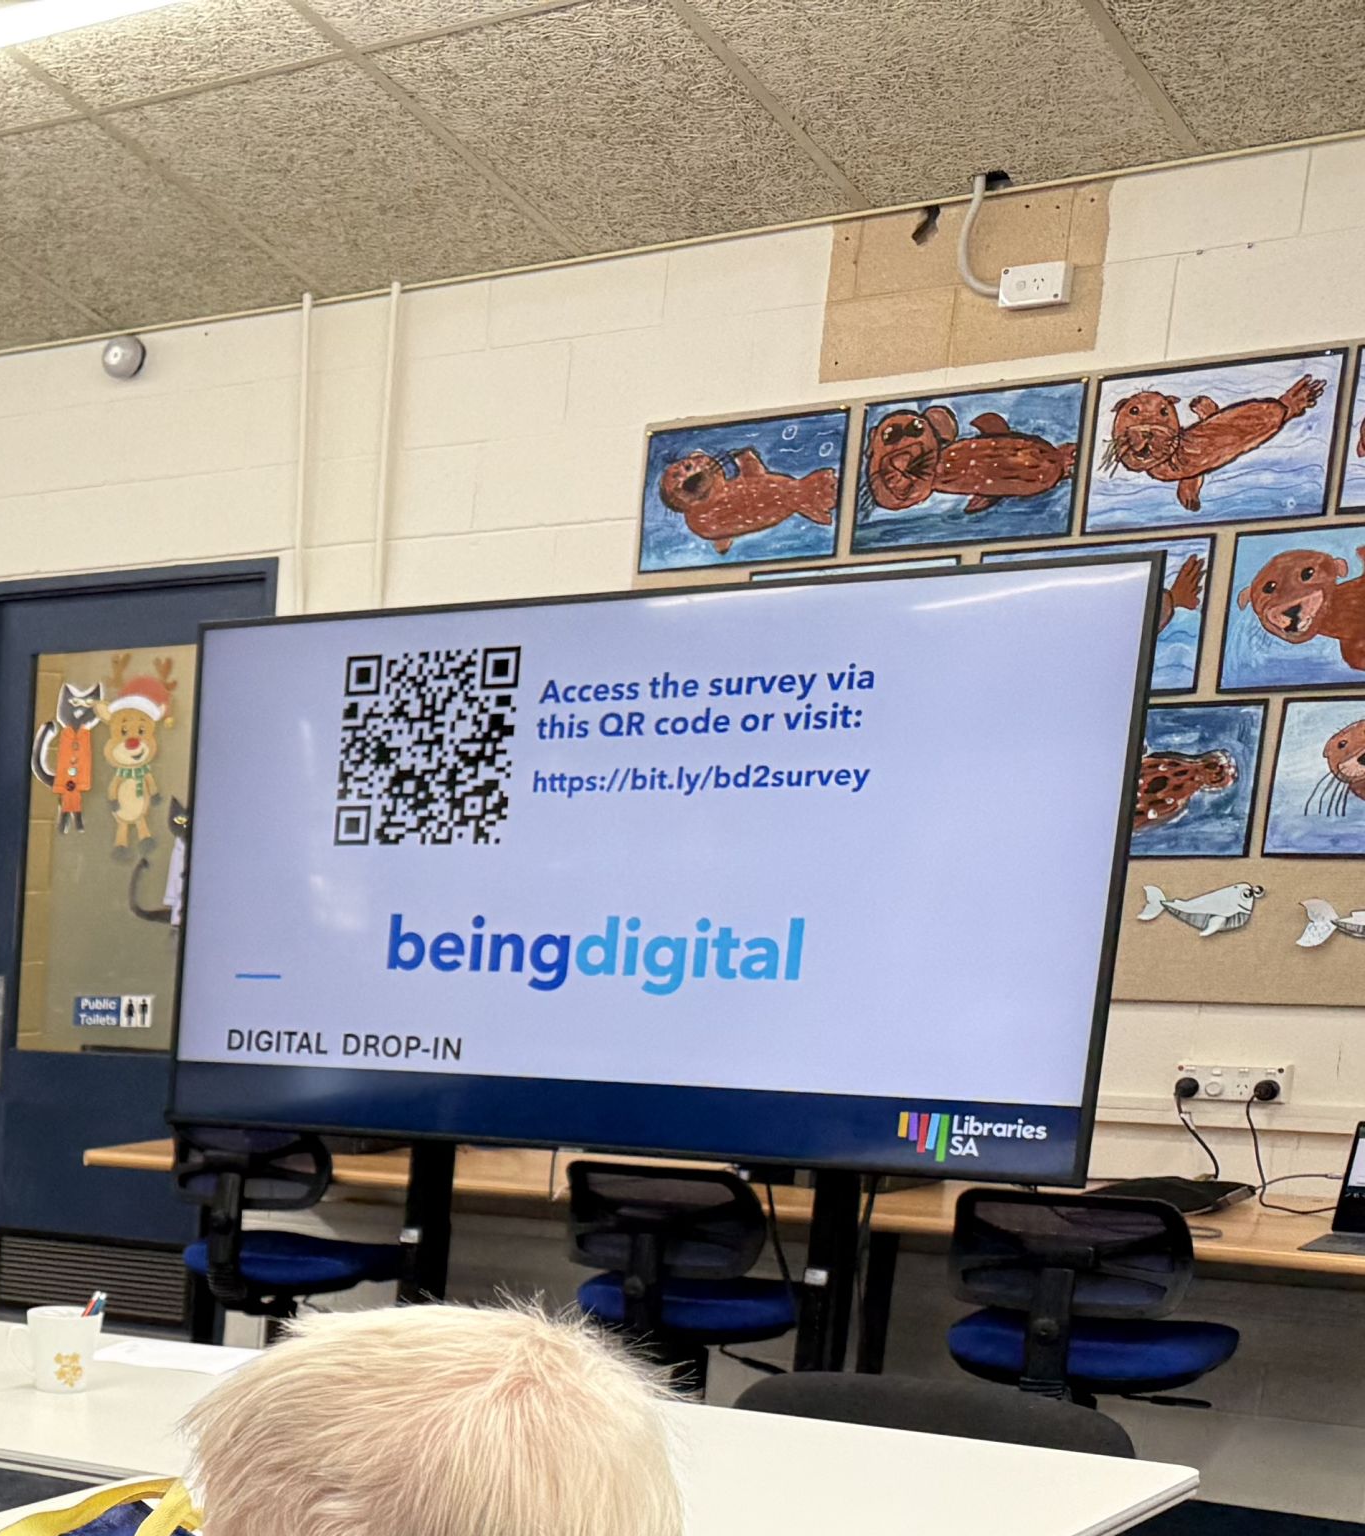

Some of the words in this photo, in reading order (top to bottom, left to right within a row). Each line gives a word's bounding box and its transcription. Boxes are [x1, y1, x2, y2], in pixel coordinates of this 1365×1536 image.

[538, 678, 641, 705] Access
[648, 671, 700, 699] the
[708, 672, 818, 701] survey
[826, 663, 875, 691] via
[536, 711, 590, 740] this
[598, 711, 645, 737] QR
[654, 706, 731, 735] code
[740, 711, 774, 733] or
[783, 702, 864, 731] visit:
[532, 763, 872, 799] https://bit.ly/bd2survey
[386, 913, 806, 997] beingdigital
[79, 1012, 117, 1026] Toilets
[80, 998, 117, 1010] Public
[226, 1027, 329, 1056] DIGITAL
[340, 1031, 463, 1061] DROP-IN
[951, 1114, 1048, 1140] Libraries
[949, 1135, 979, 1157] SA
